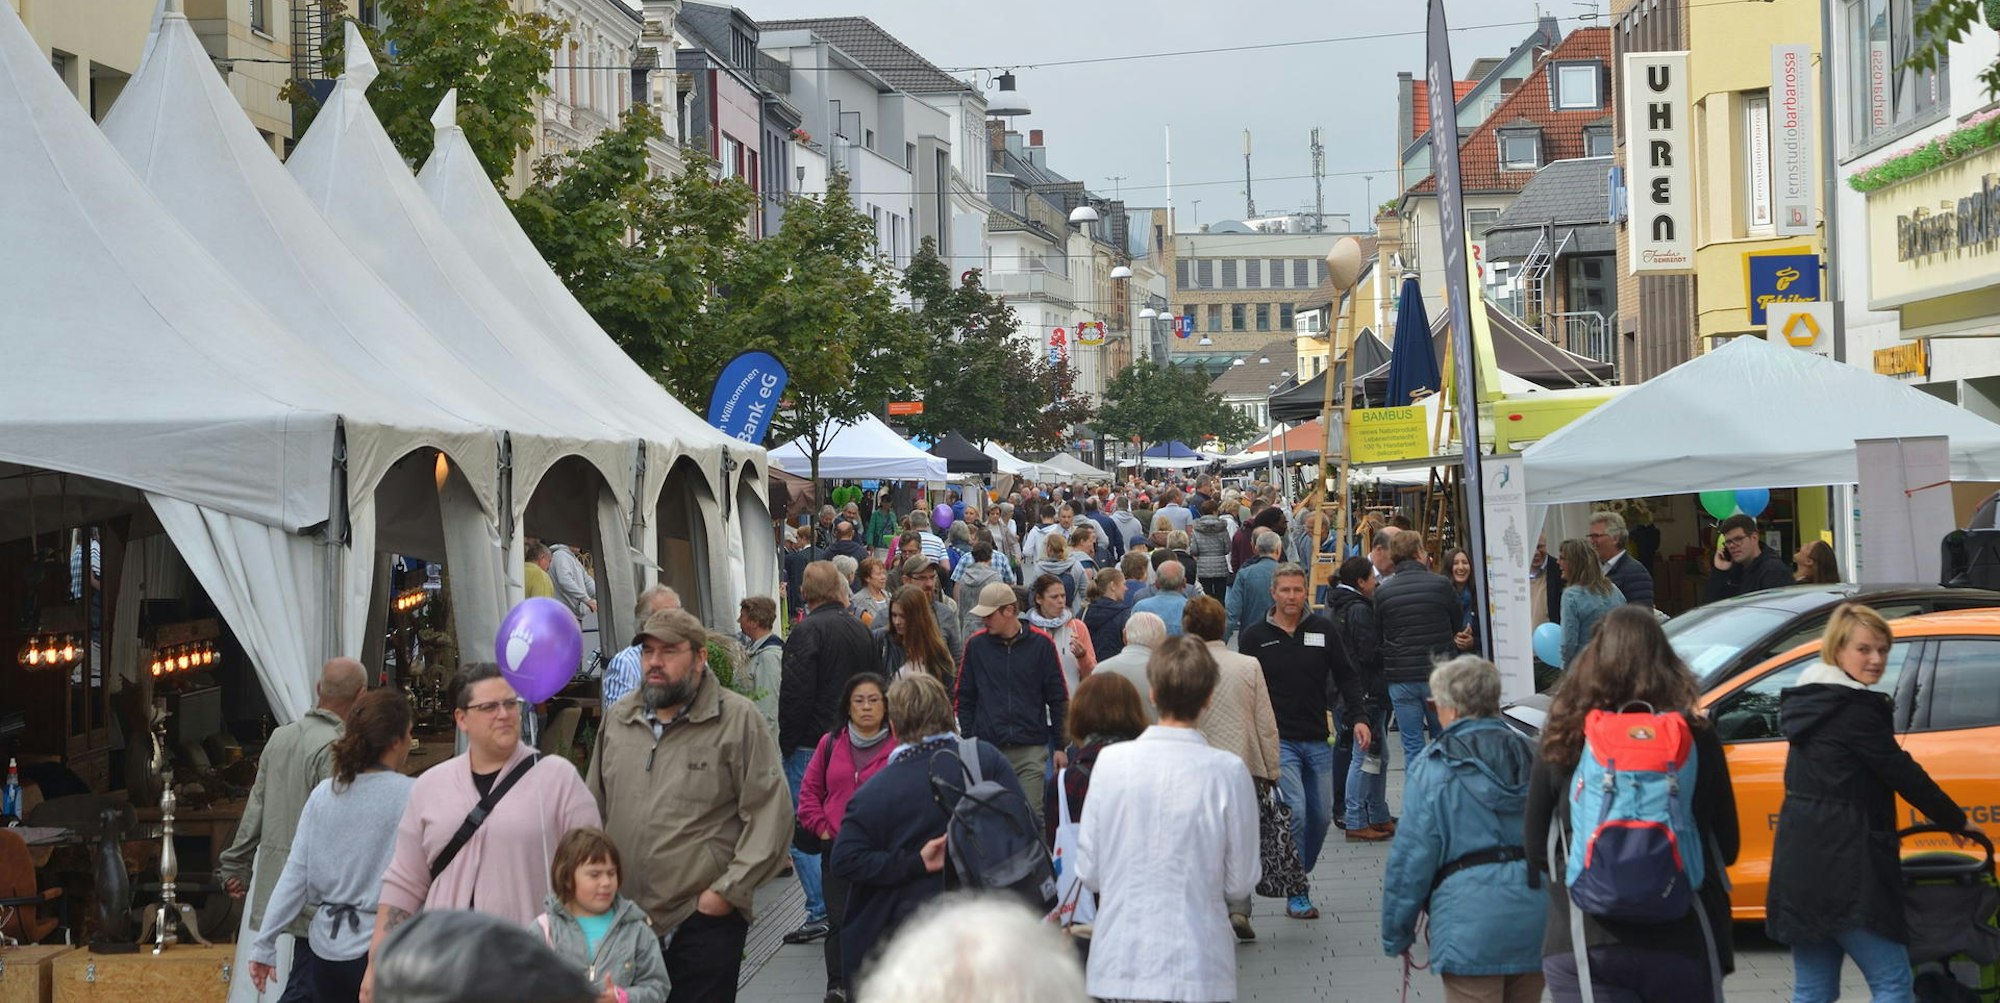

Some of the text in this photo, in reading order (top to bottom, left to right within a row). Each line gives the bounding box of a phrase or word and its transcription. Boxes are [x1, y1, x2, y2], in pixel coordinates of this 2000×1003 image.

[1647, 65, 1675, 241] UHREN
[1783, 52, 1799, 199] lernstudiobarbarossa
[721, 368, 759, 422] Willkommen
[737, 373, 778, 443] Bank eG
[1362, 409, 1413, 422] BAMBUS
